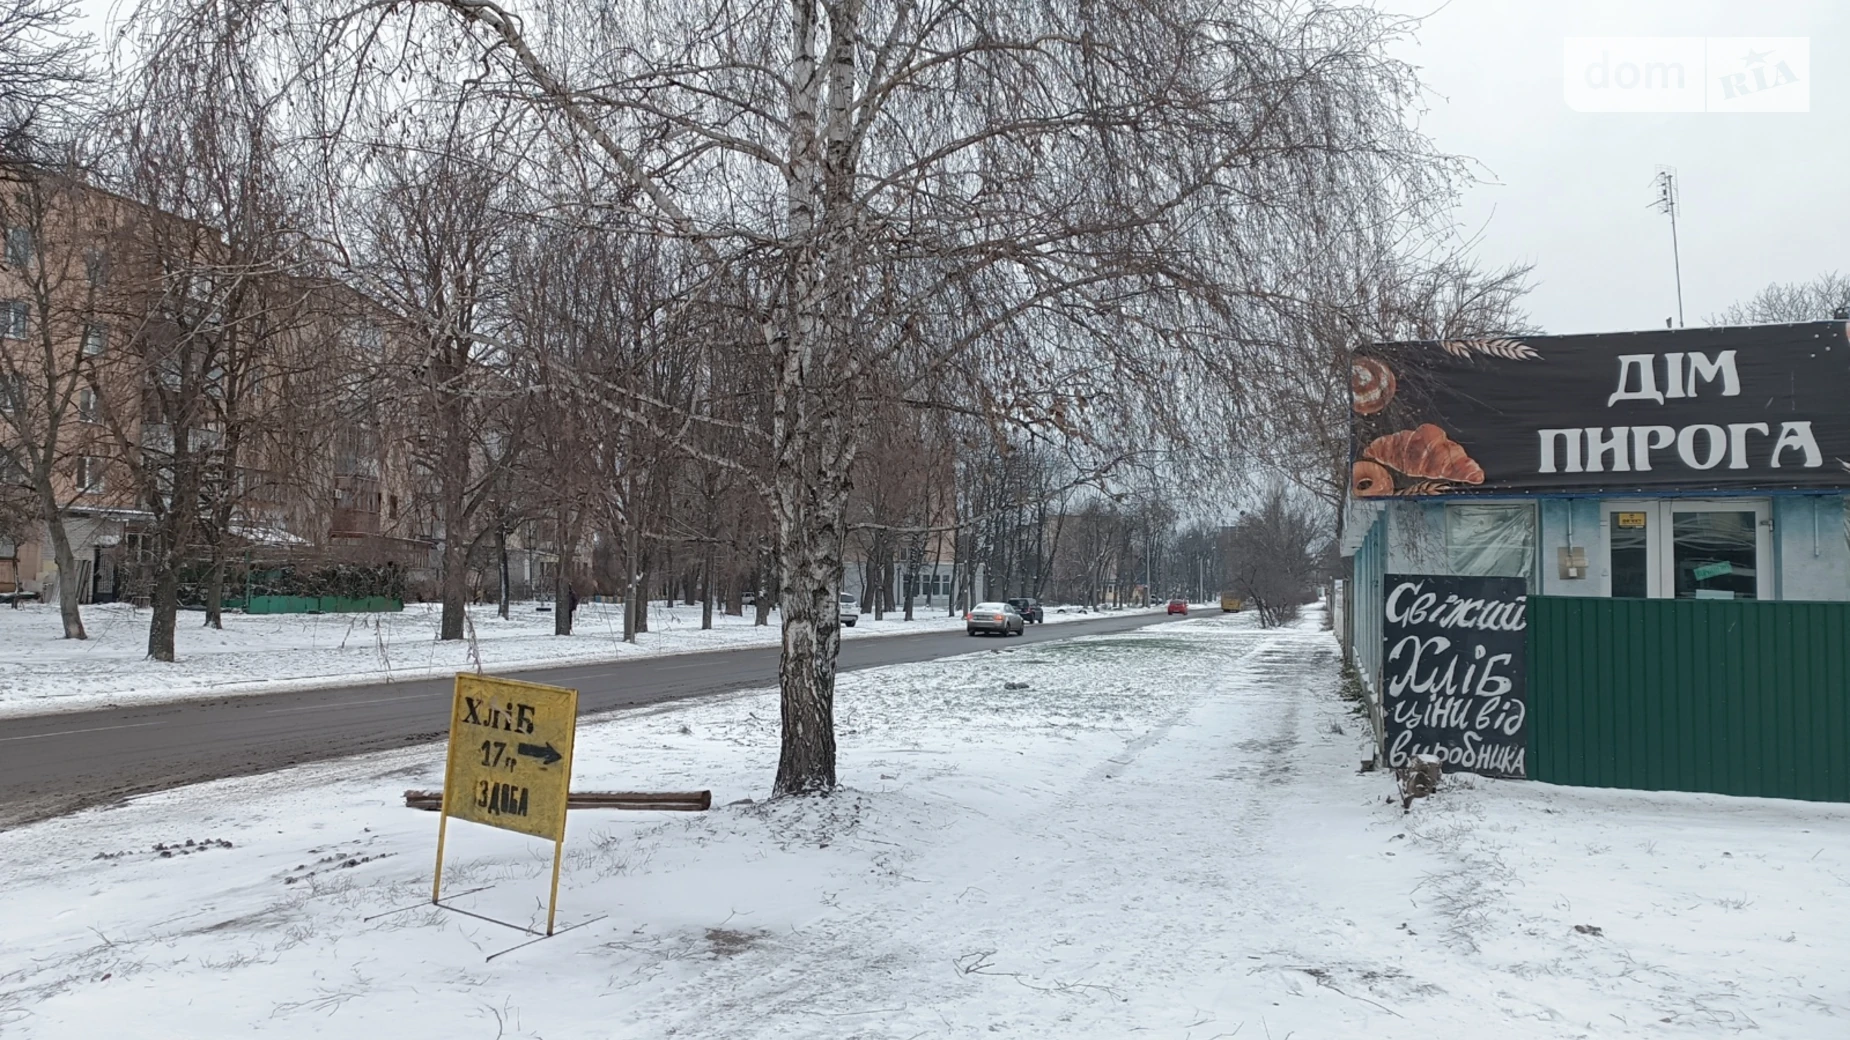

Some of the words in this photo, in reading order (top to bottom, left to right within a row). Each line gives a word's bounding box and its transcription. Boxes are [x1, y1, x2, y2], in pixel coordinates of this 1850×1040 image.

[1607, 349, 1741, 408] ДІМ
[1537, 420, 1824, 475] ПИРОГА
[1385, 579, 1528, 631] Свіжий
[1475, 696, 1526, 736] від
